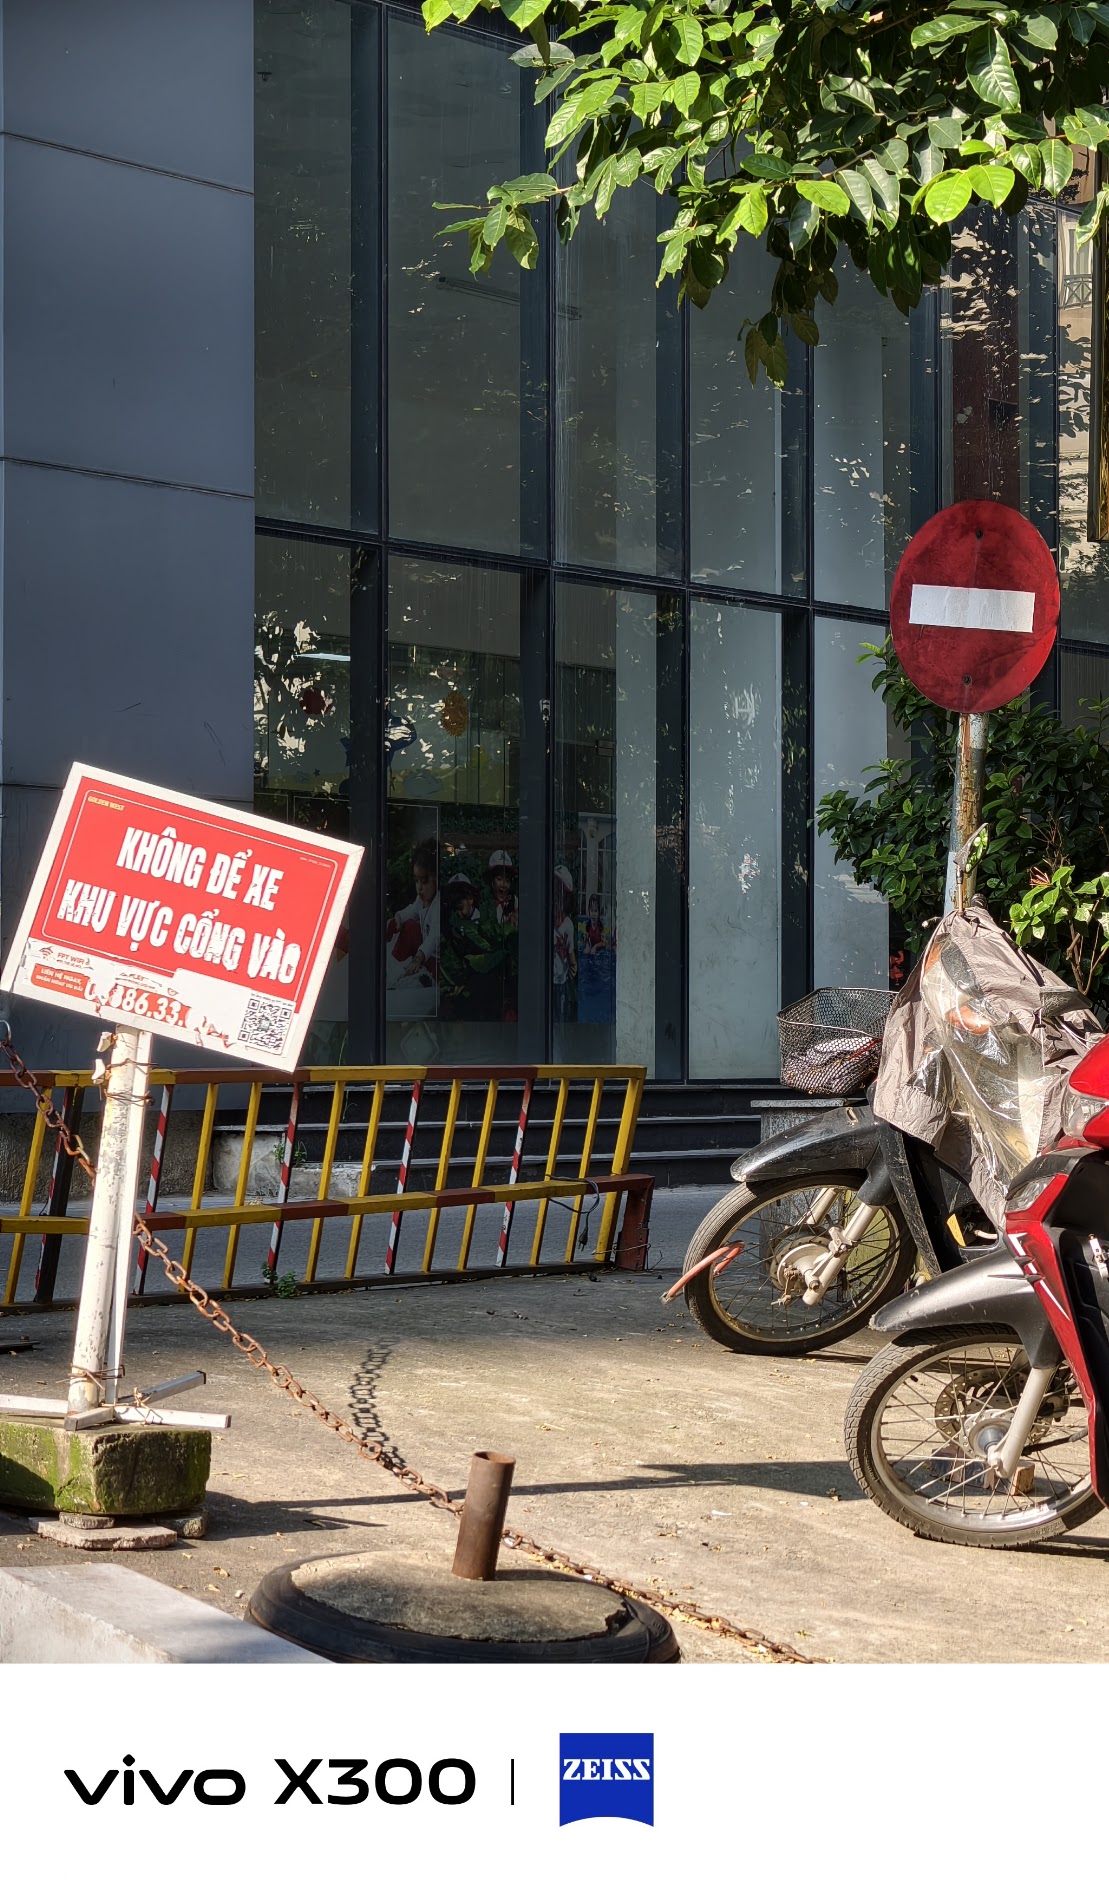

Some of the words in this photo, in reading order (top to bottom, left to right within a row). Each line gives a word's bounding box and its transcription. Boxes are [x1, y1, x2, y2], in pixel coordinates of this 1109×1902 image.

[116, 826, 207, 889] KHÔNG
[205, 848, 253, 900] ĐỂ
[242, 863, 285, 911] XE
[56, 878, 117, 934] KHU
[115, 894, 174, 952] VỰC
[173, 908, 246, 972] CỔNG
[246, 927, 301, 984] VÀO
